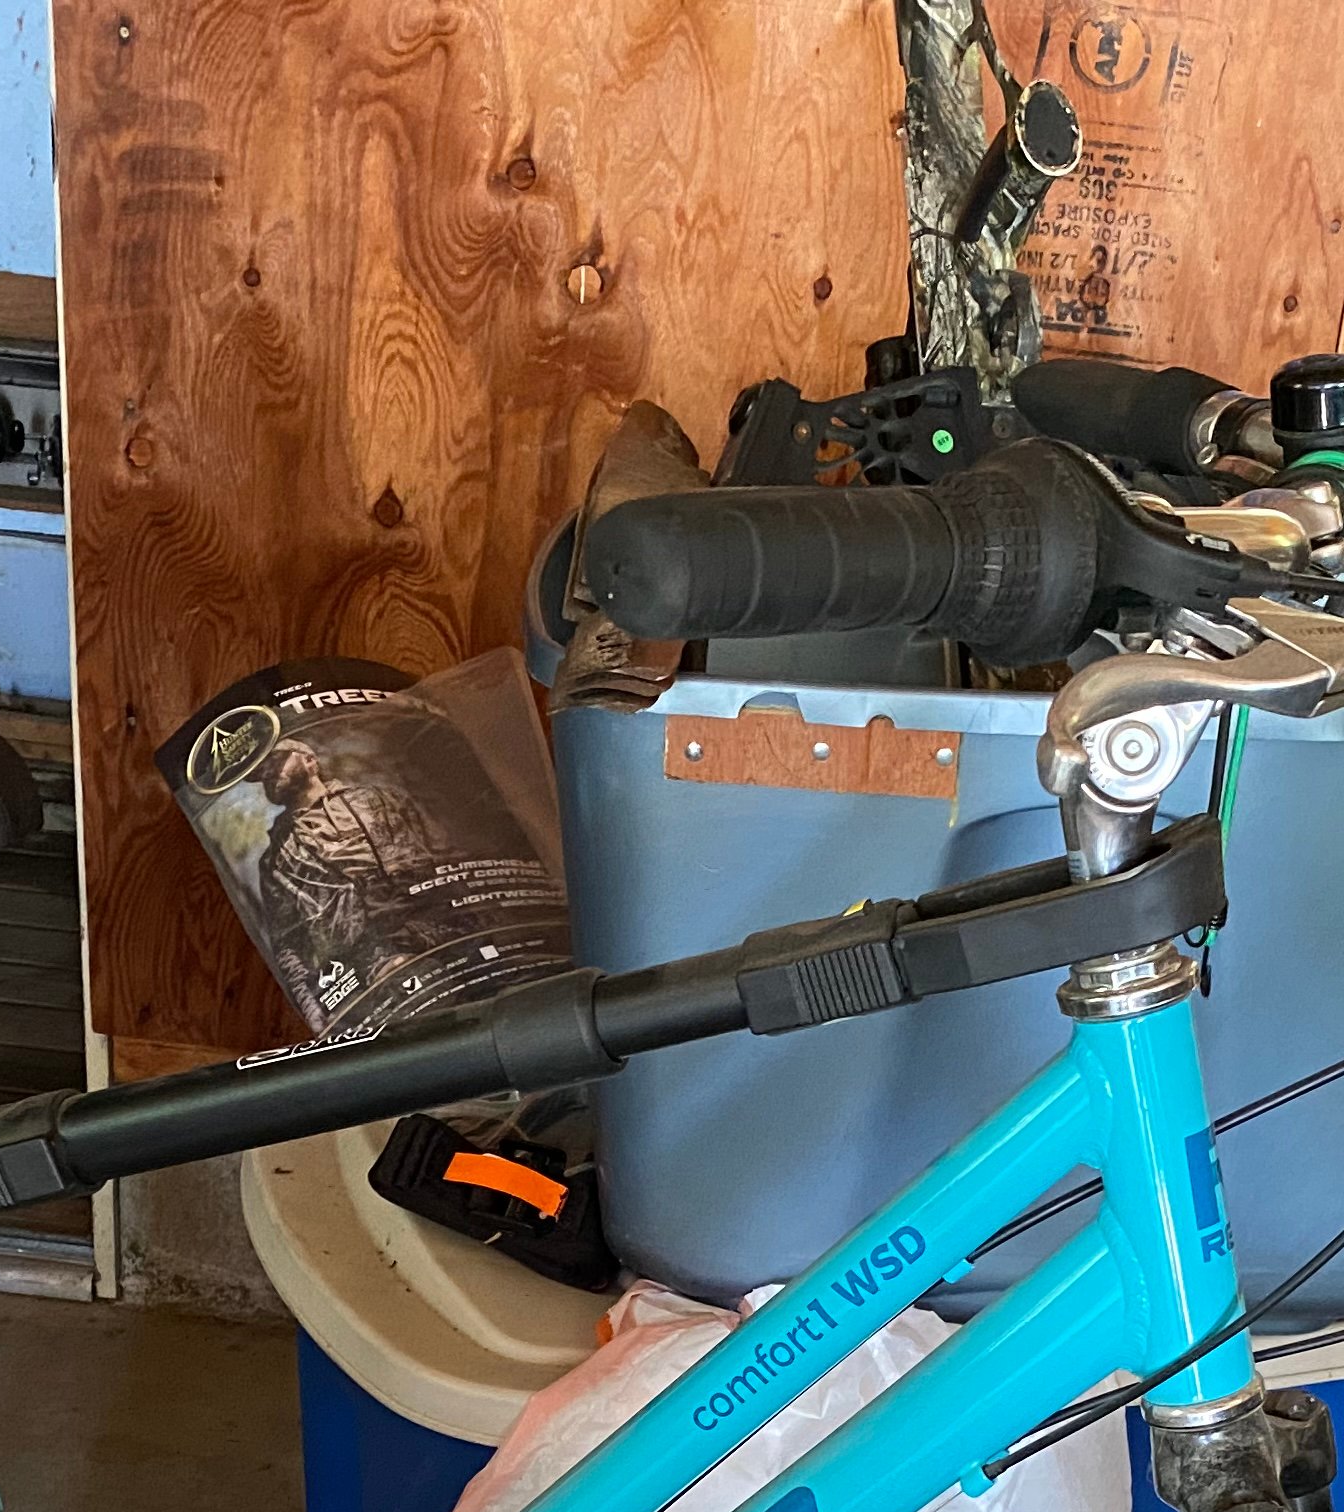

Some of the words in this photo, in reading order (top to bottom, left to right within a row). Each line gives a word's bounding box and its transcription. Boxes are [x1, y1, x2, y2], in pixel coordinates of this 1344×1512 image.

[1055, 203, 1152, 230] EXPOSURE
[1091, 226, 1121, 244] FOR
[408, 871, 470, 896] SCENT
[324, 975, 360, 1011] EDGE
[830, 1225, 927, 1308] WSD
